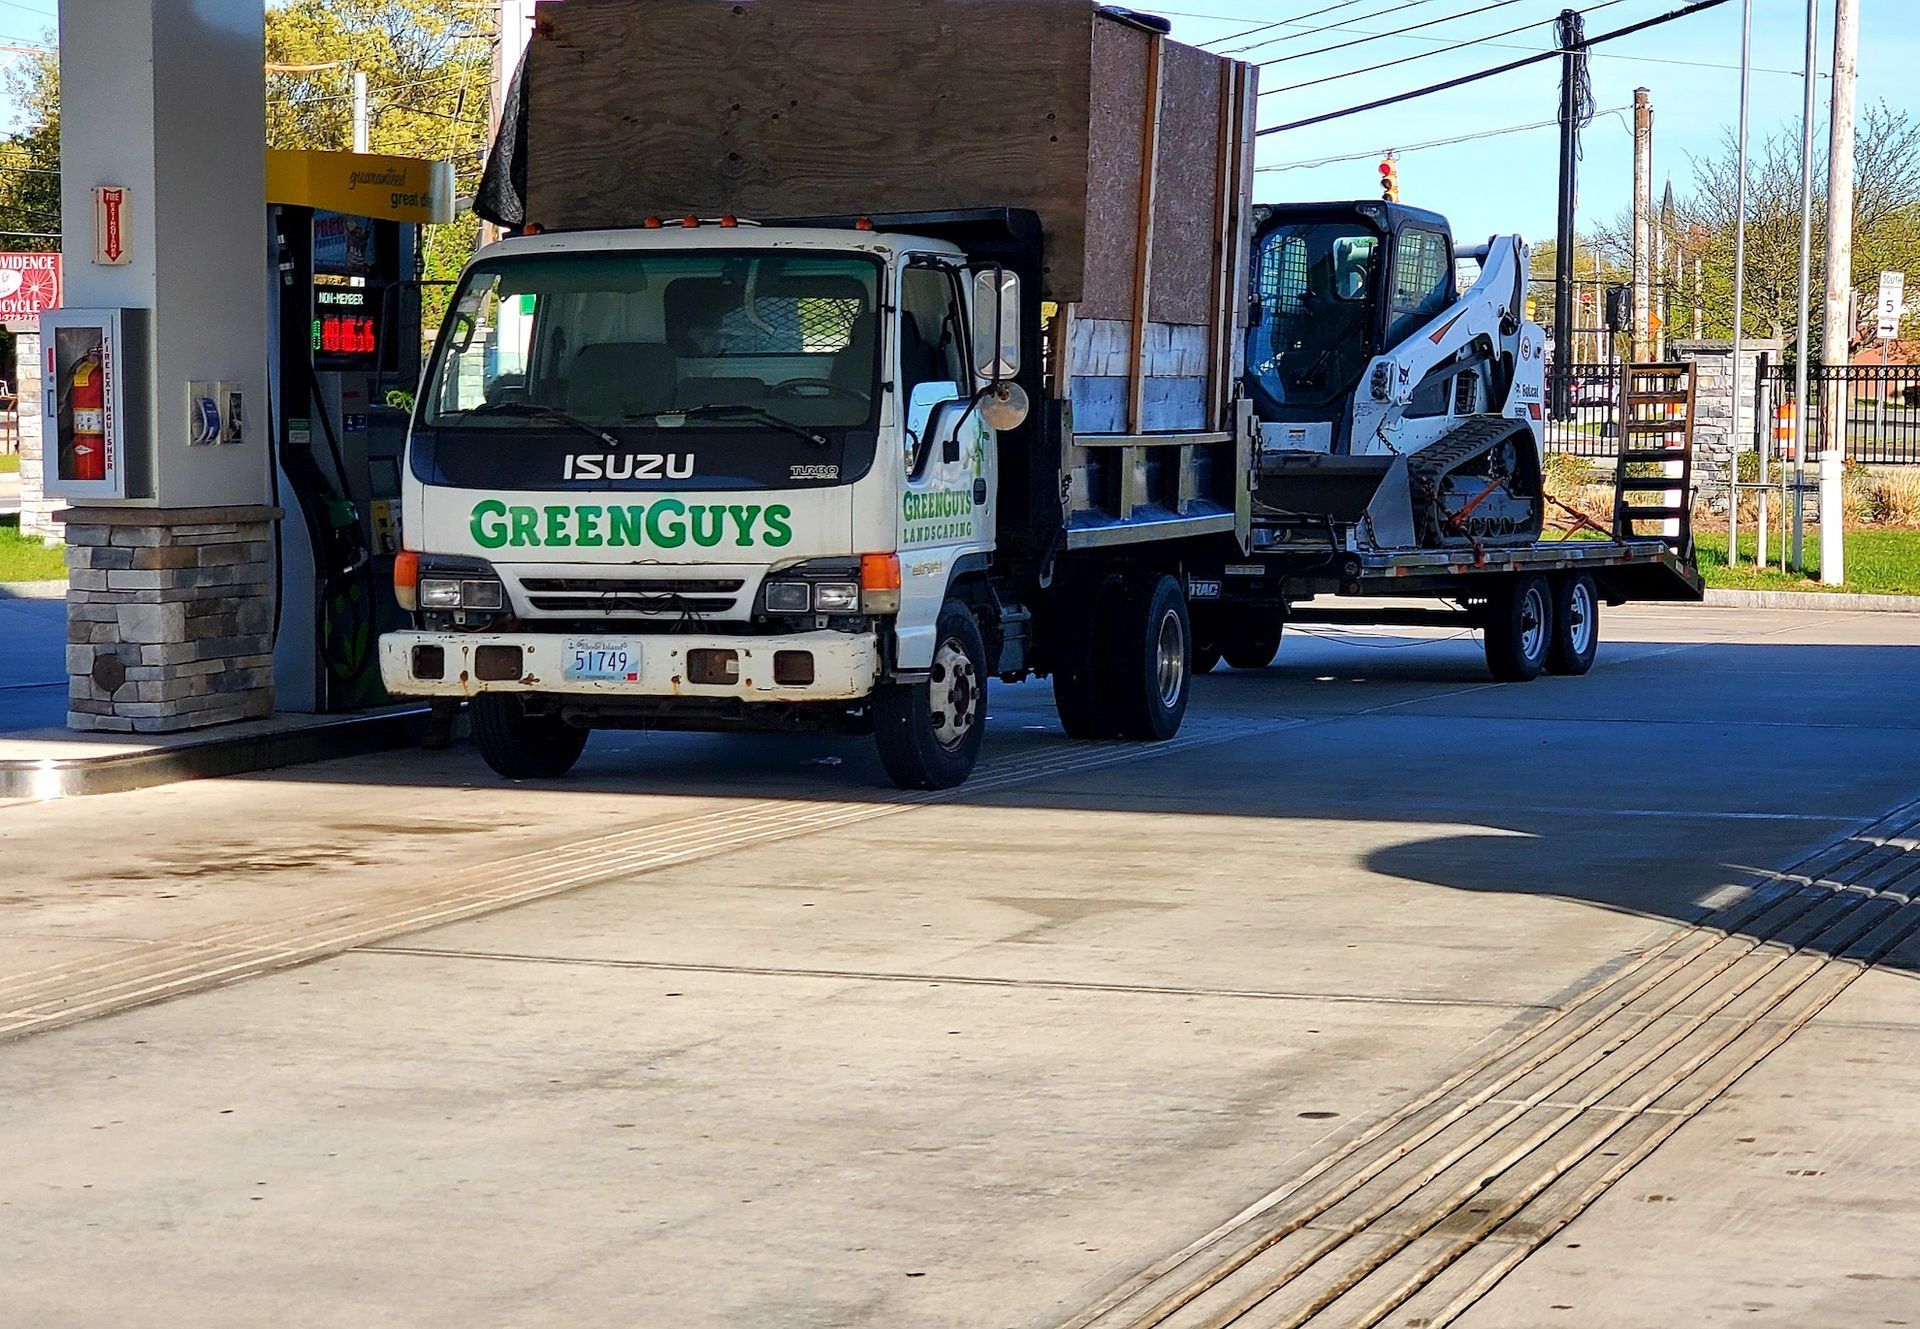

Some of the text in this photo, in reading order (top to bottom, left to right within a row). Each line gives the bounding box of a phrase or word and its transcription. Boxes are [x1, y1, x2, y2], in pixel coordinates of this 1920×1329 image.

[348, 167, 407, 191] guaranteed
[105, 192, 120, 201] FIRE
[391, 192, 418, 209] great
[0, 256, 55, 270] VIDENCE
[1883, 274, 1903, 285] SOUTH
[318, 291, 364, 305] NON-MEMBER
[1886, 299, 1894, 313] 5
[105, 373, 113, 470] EXTINGUISHER
[563, 453, 695, 480] ISUZU
[790, 464, 839, 476] TURBO
[903, 487, 972, 522] GREENGUYS
[470, 498, 792, 549] GREENGUYS
[903, 521, 972, 544] LANDSCAPING
[575, 650, 627, 672] 51749
